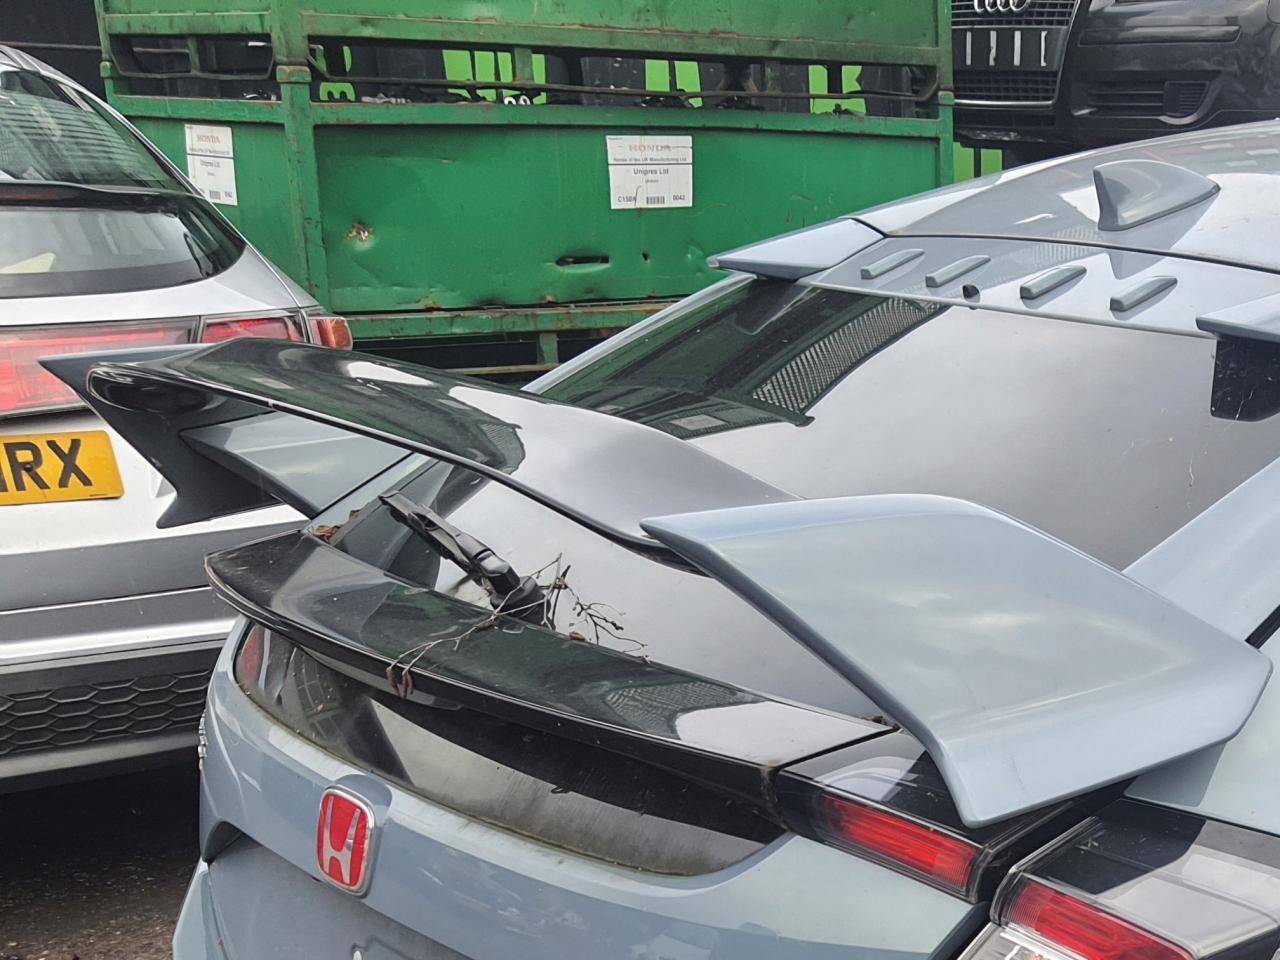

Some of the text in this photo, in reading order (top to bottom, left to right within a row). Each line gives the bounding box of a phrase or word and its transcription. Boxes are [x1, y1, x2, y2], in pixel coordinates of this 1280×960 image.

[197, 134, 221, 143] HONDA
[628, 144, 672, 152] HONDA
[633, 168, 658, 176] Unipres
